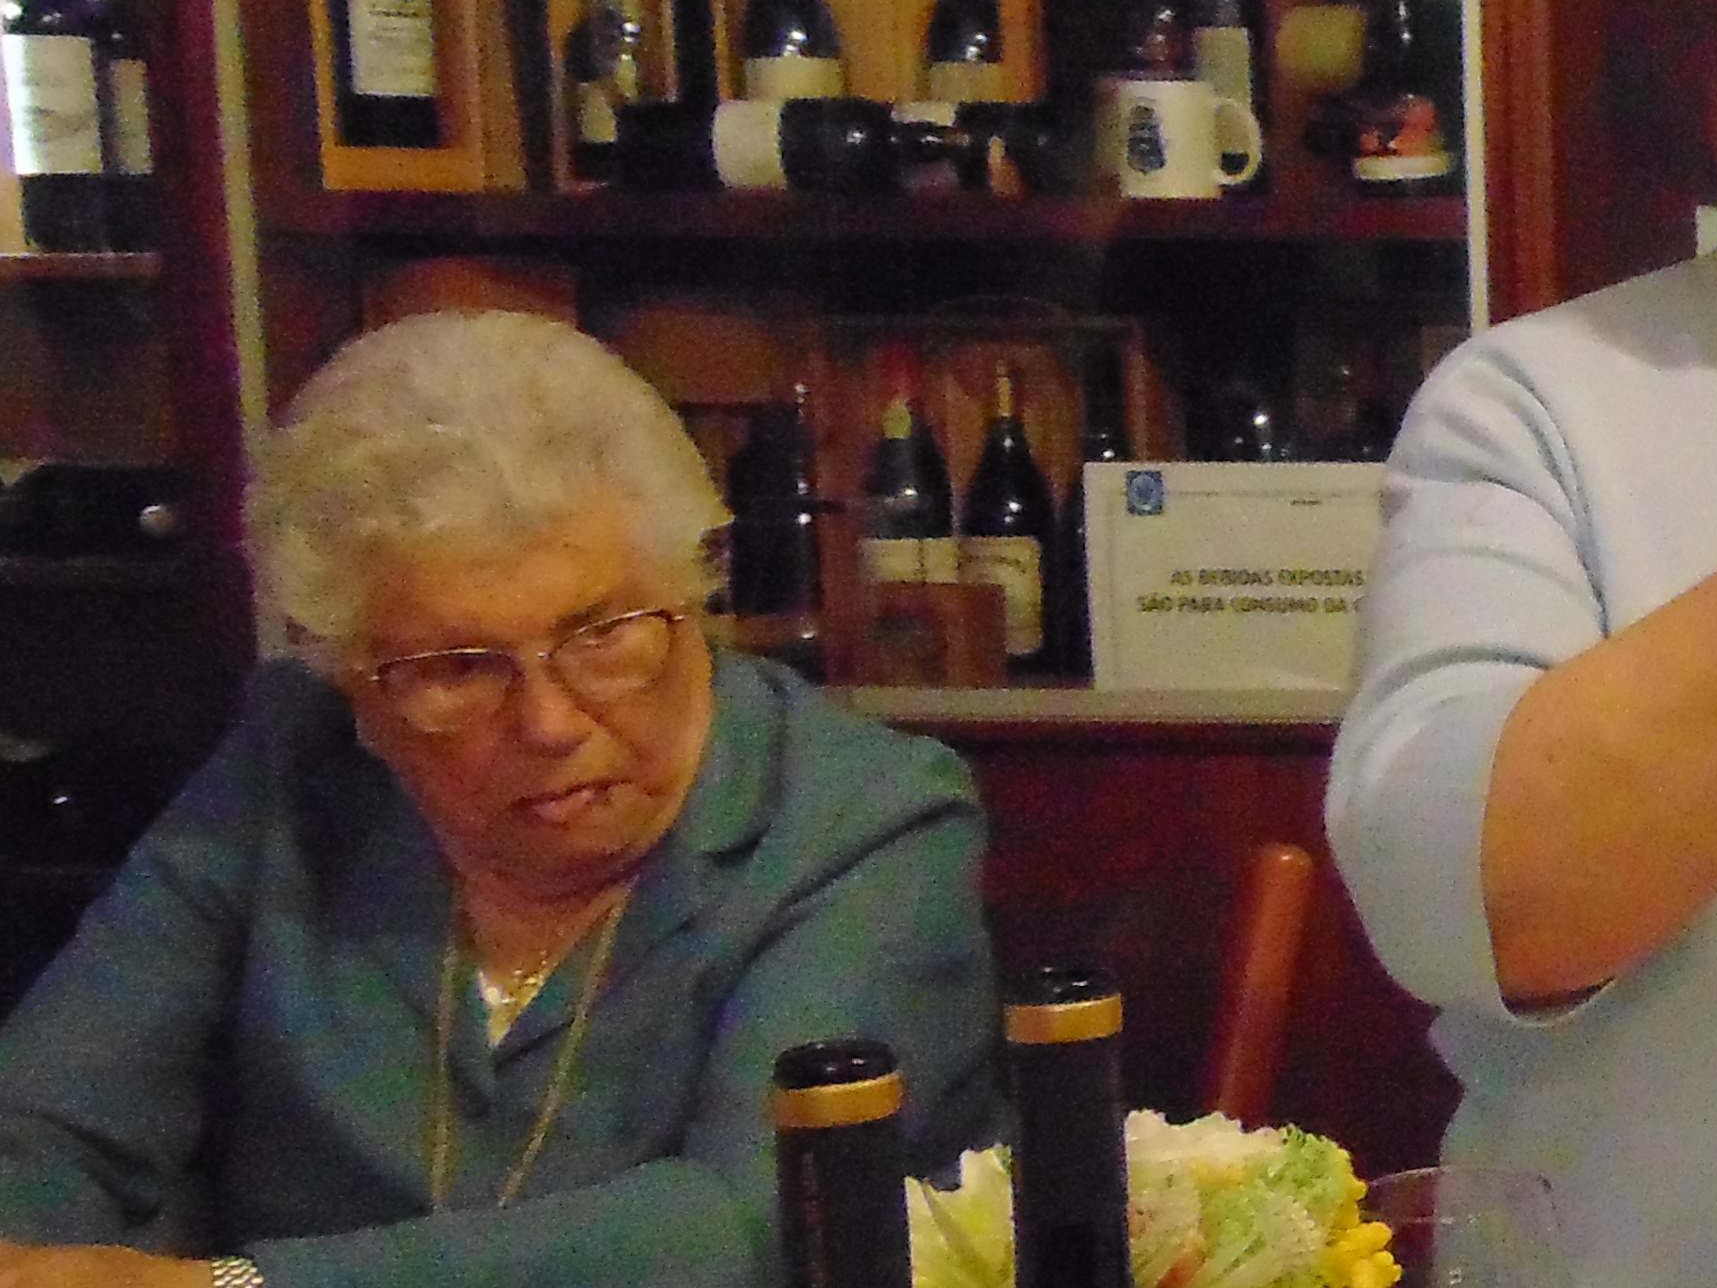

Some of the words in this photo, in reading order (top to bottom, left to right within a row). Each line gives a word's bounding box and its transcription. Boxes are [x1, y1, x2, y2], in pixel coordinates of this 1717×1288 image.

[1170, 570, 1194, 586] AS
[1199, 569, 1274, 587] BEBIDAS
[1278, 569, 1365, 587] EXPOSTAS
[1137, 591, 1173, 613] SÃO
[1177, 596, 1225, 613] PARA
[1230, 596, 1319, 613] CONSUMO
[1323, 596, 1348, 613] DA
